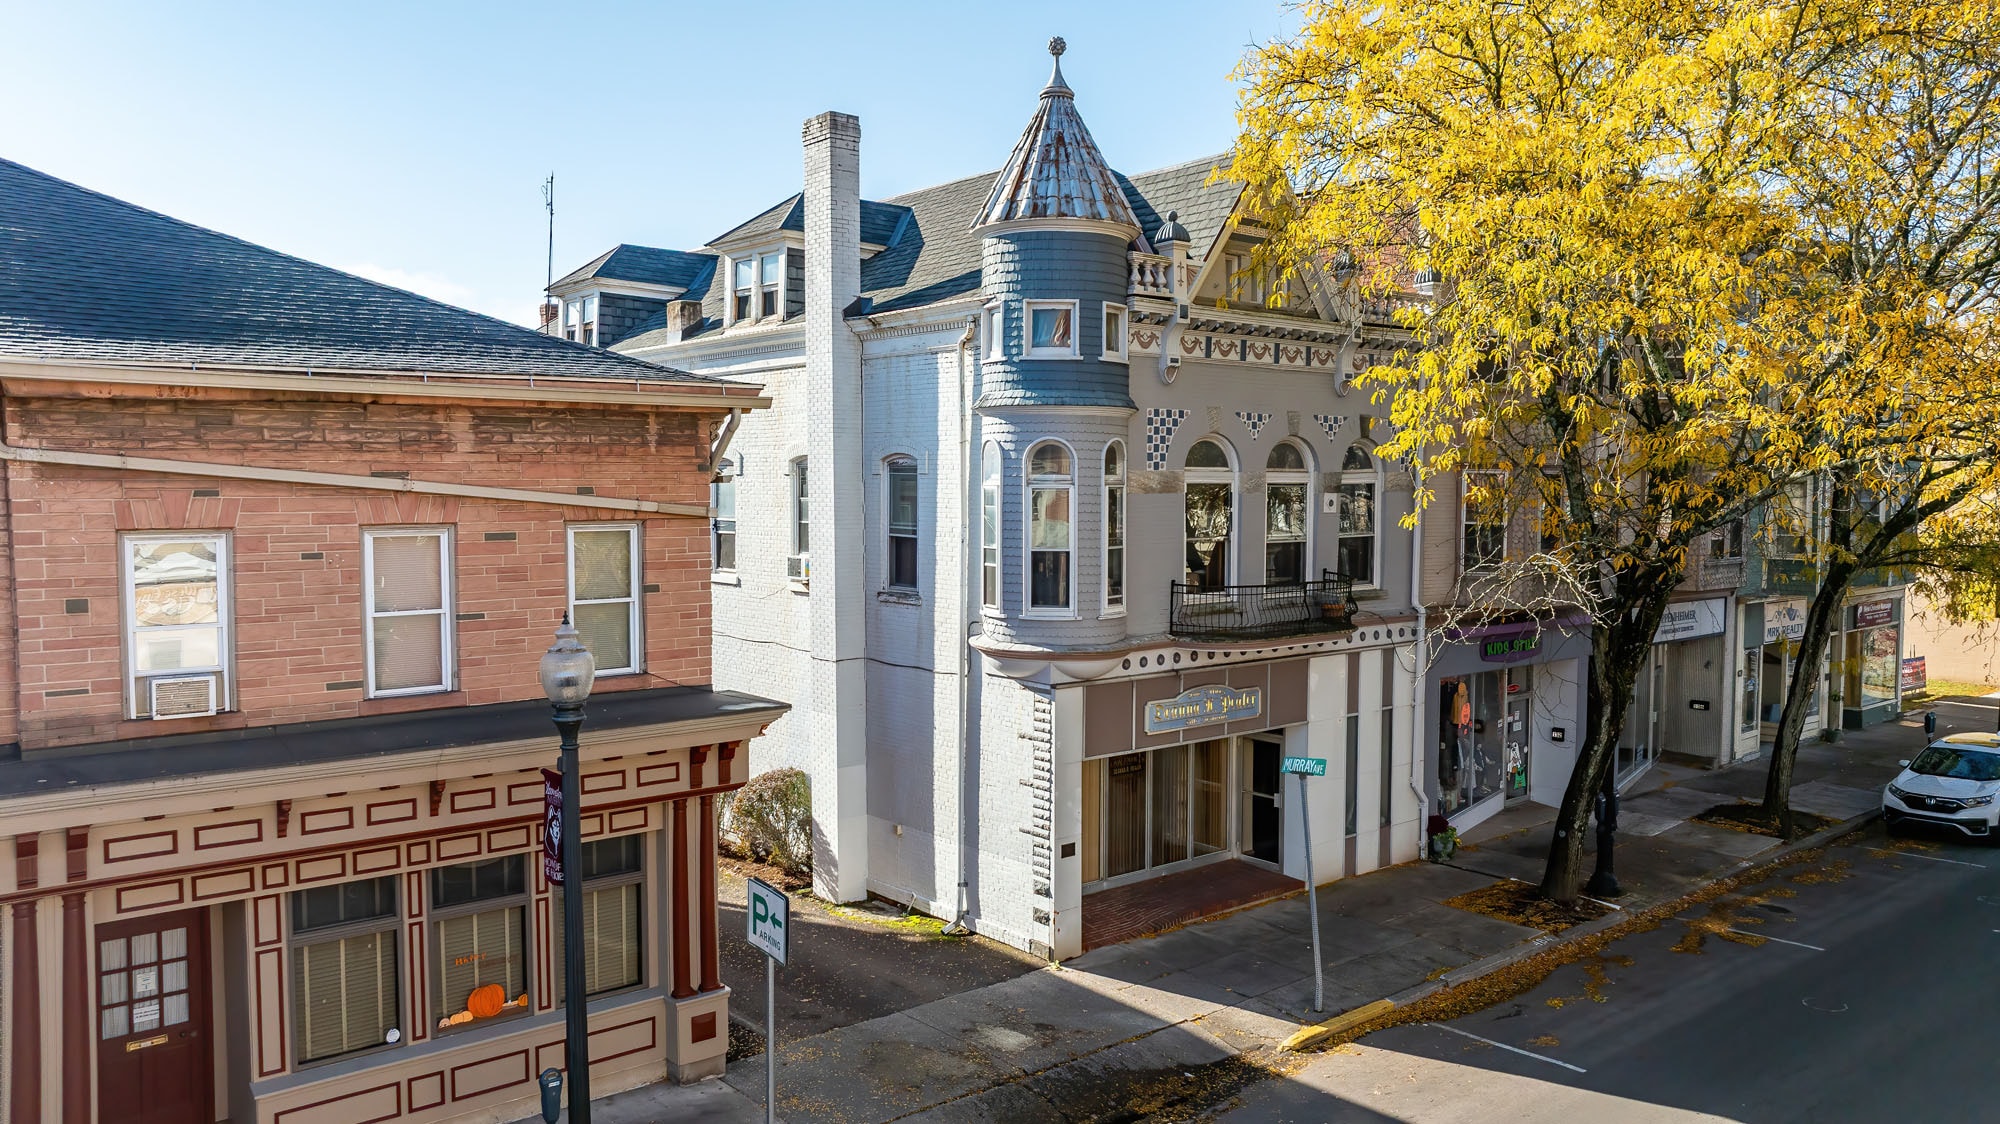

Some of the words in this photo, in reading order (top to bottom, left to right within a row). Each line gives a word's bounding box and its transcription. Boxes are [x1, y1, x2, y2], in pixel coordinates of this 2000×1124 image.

[1660, 609, 1696, 623] PPENHEIMER
[1767, 626, 1780, 638] MRK
[1782, 623, 1805, 635] REALTY
[1487, 641, 1509, 656] KIDS
[1283, 758, 1316, 773] MURRAY
[1313, 764, 1325, 775] AVE
